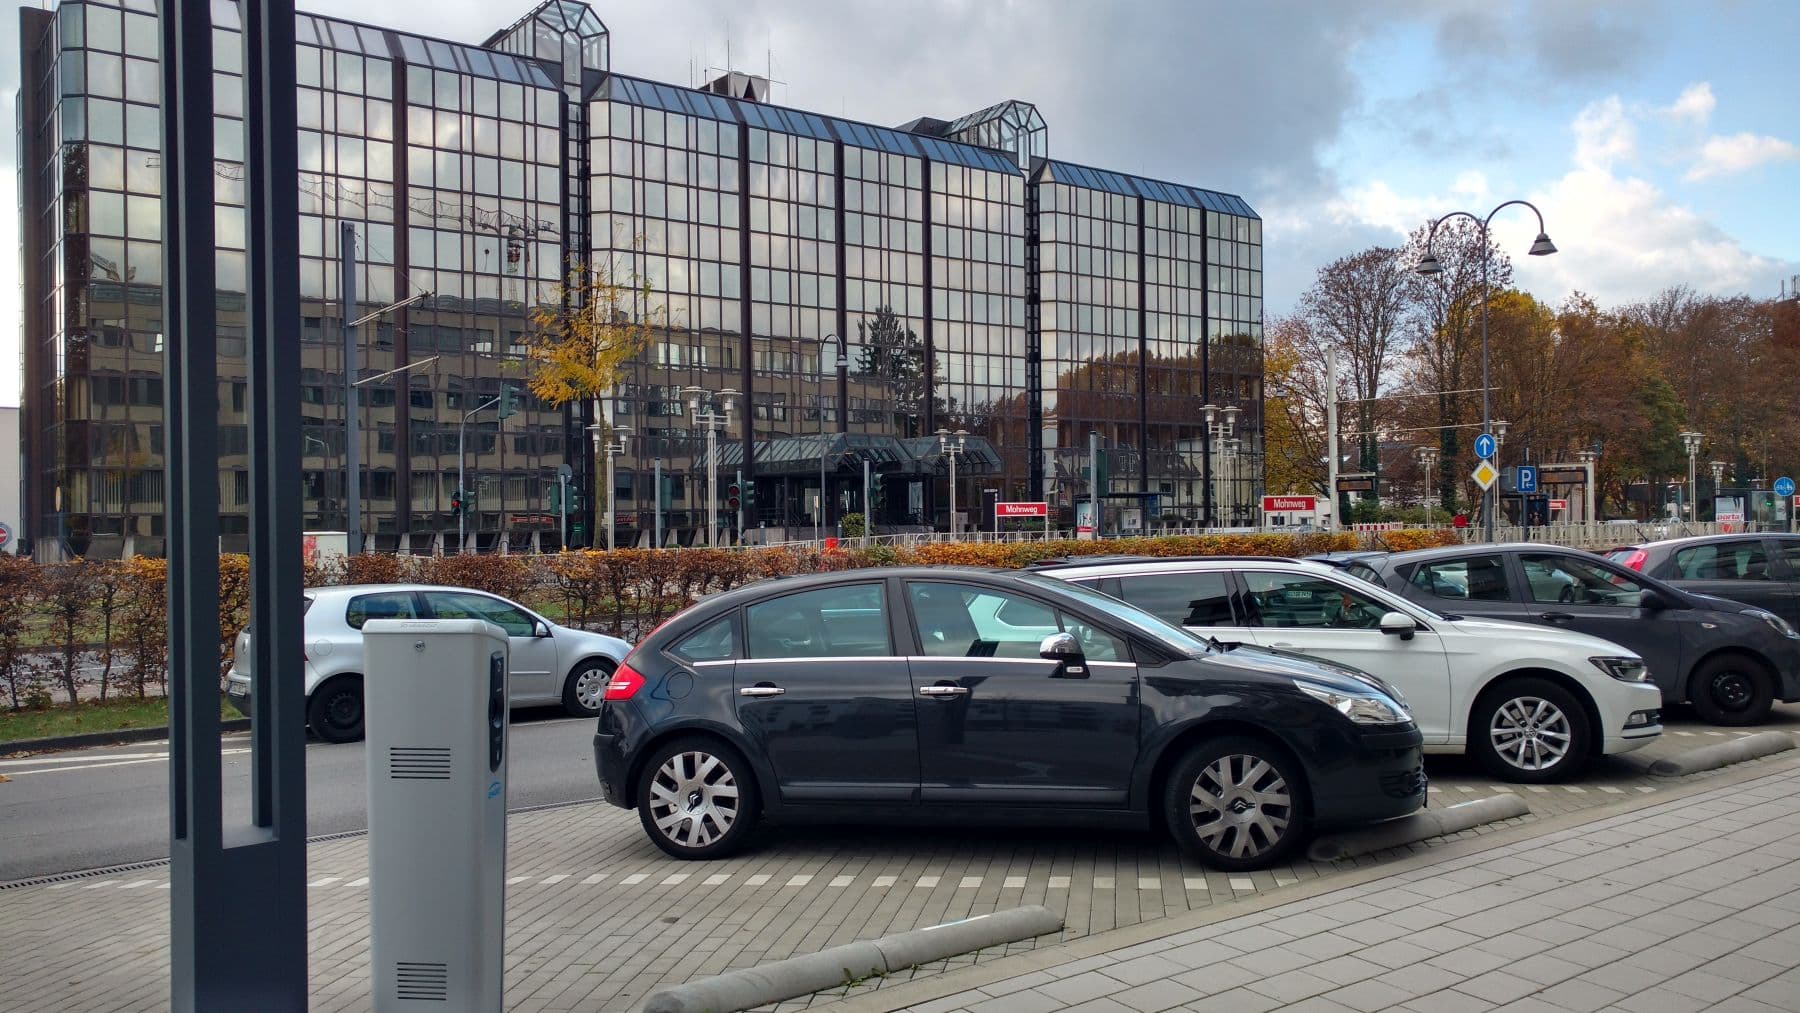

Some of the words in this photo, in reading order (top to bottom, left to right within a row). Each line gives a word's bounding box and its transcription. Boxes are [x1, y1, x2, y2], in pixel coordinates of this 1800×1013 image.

[1521, 469, 1532, 488] P
[1005, 504, 1038, 515] Mohnweg
[1273, 498, 1306, 510] Mohnweg
